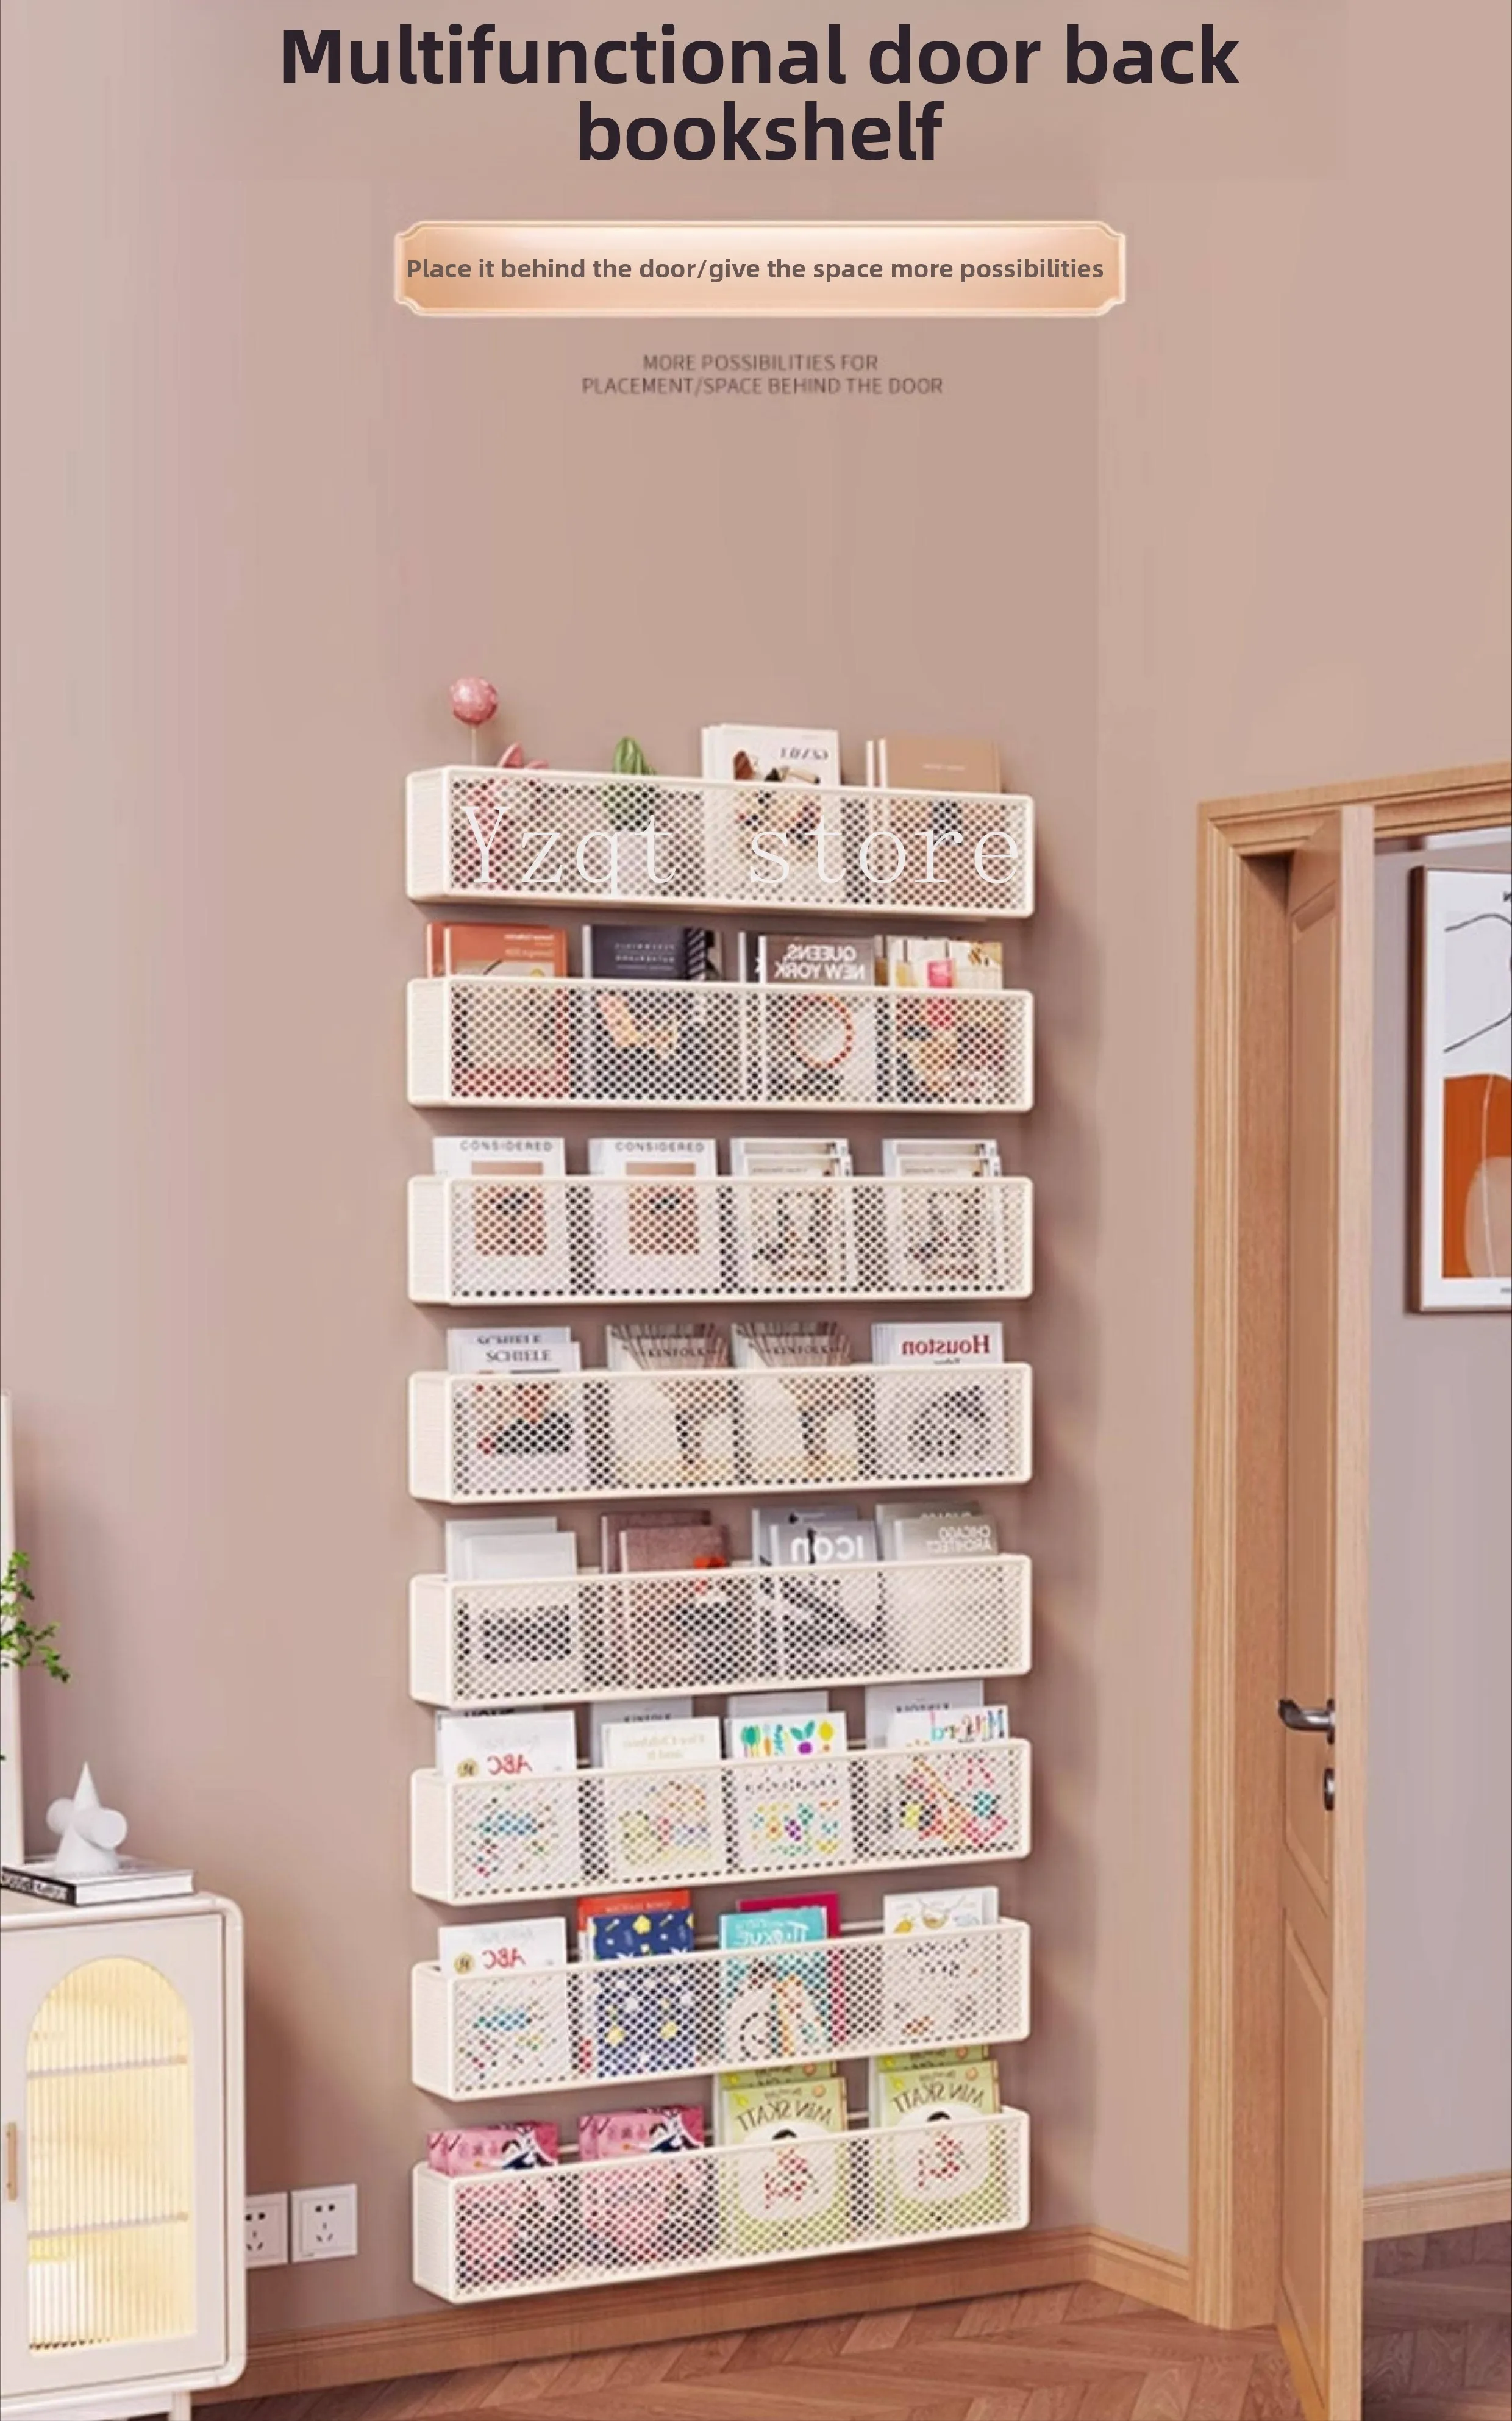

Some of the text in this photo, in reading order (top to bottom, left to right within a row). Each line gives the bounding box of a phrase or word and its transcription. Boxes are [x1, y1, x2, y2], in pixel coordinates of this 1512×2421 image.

[459, 1139, 554, 1152] CONSIDERED
[615, 1140, 705, 1153] CONSIDERED
[486, 1349, 551, 1363] SCHIELE
